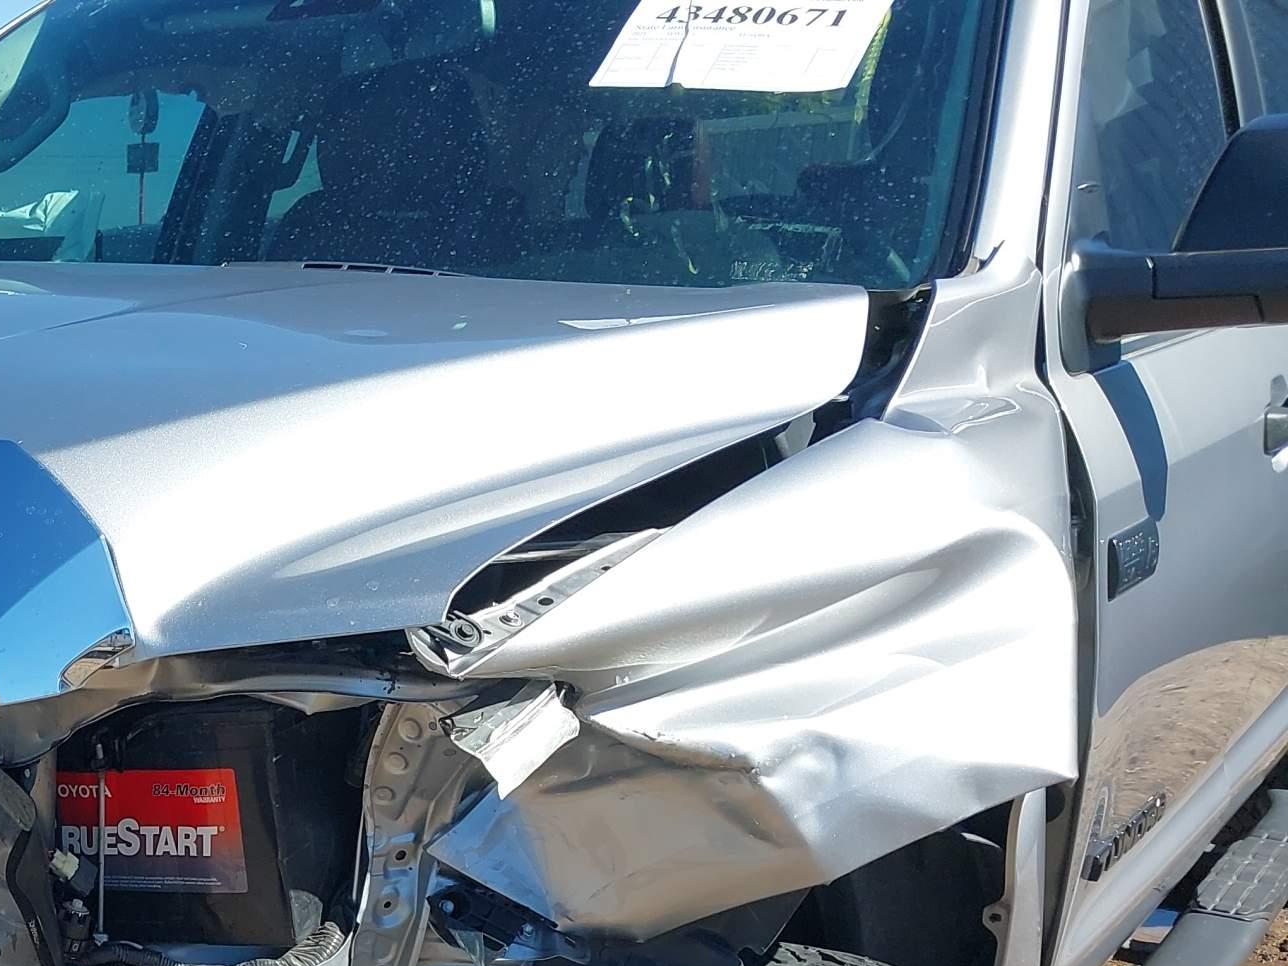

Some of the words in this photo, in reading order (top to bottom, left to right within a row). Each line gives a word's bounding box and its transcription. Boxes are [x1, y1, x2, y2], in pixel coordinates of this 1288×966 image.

[656, 5, 848, 27] 43480671
[57, 784, 112, 798] OYOTA
[152, 784, 226, 797] 84-Month
[62, 818, 218, 857] RUESTART
